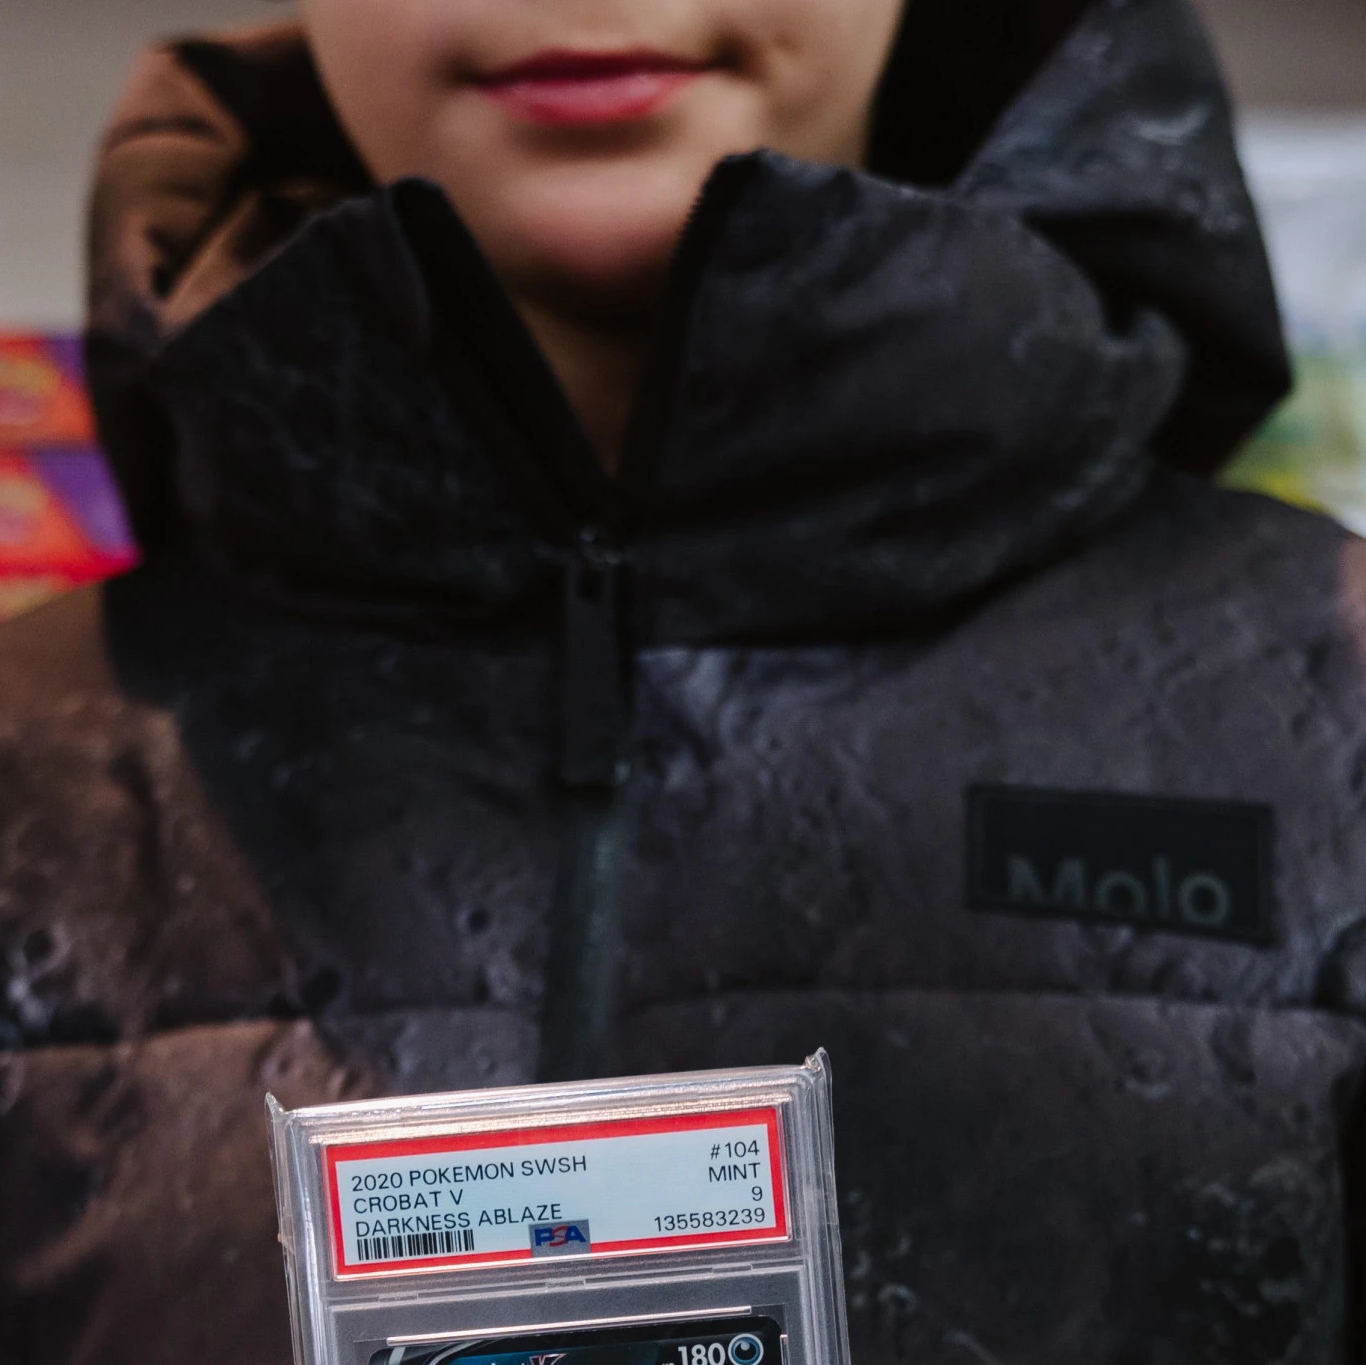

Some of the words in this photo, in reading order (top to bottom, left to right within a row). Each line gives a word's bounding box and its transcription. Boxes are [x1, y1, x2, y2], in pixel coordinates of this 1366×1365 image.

[1006, 853, 1233, 928] Molo
[710, 1140, 760, 1160] #104
[351, 1172, 403, 1192] 2020
[410, 1162, 514, 1187] POKEMON
[521, 1155, 587, 1176] SWSH
[708, 1162, 761, 1182] MINT
[353, 1191, 442, 1214] CROBAT
[450, 1189, 463, 1206] V
[751, 1186, 763, 1202] 9
[356, 1212, 471, 1237] DARKNESS
[478, 1203, 562, 1227] ABLAZE
[654, 1207, 765, 1232] 135583239
[534, 1225, 587, 1247] PSA
